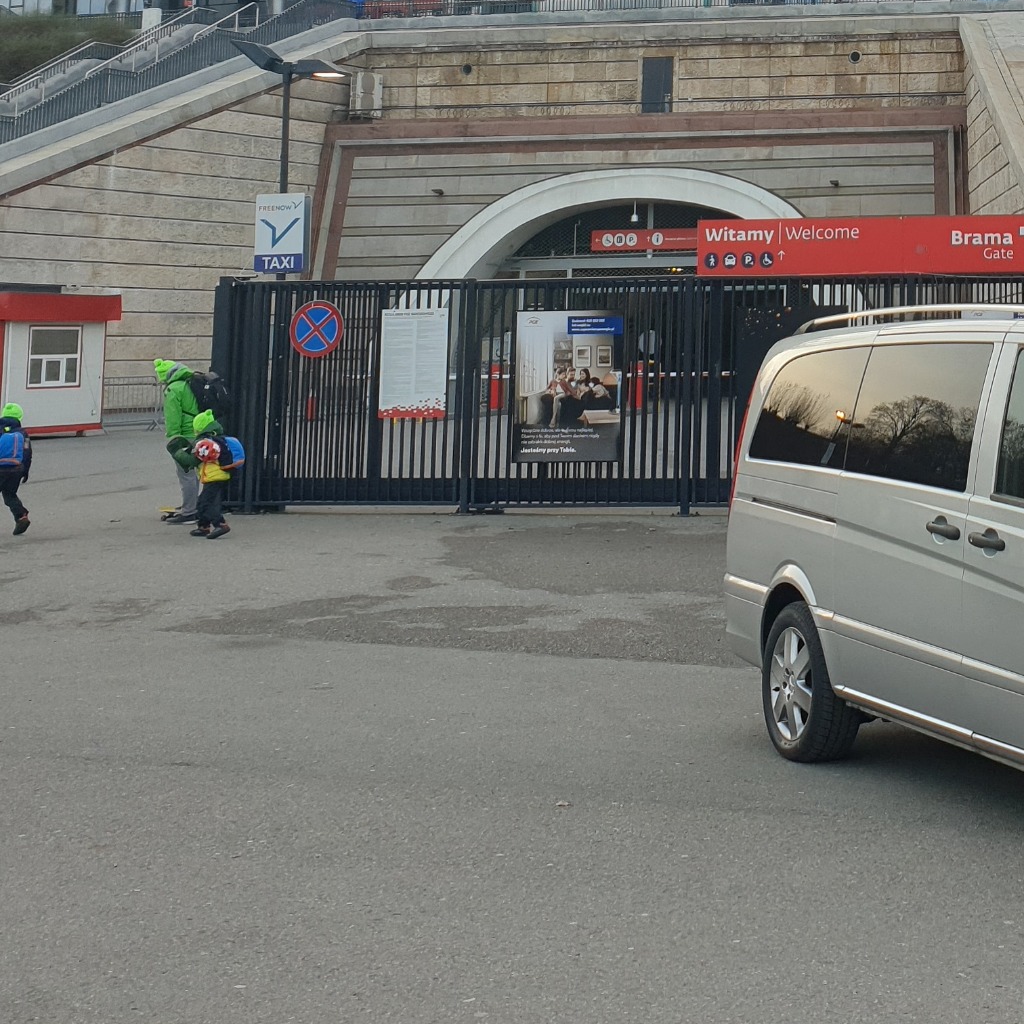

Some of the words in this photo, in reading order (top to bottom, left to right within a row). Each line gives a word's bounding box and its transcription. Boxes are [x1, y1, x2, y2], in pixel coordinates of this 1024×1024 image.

[705, 226, 775, 244] Witamy
[785, 225, 860, 240] Welcome
[951, 230, 1013, 245] Brama
[983, 247, 1014, 259] Gate
[262, 256, 294, 270] TAXI
